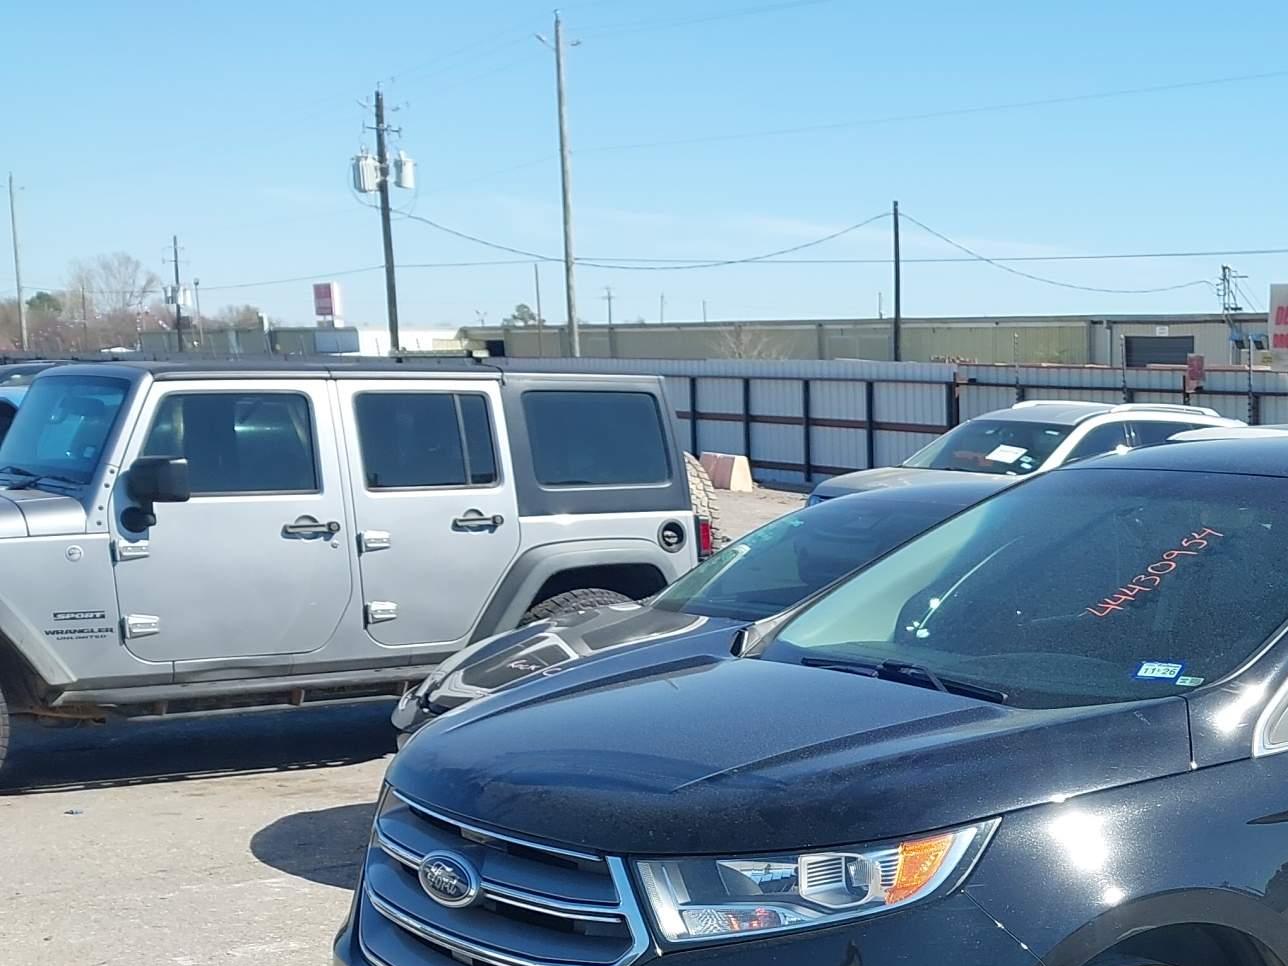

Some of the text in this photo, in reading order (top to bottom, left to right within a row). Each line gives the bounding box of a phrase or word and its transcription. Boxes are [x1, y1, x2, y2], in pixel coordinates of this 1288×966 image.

[1086, 526, 1224, 617] 44430954
[55, 611, 105, 621] SPORT
[44, 626, 114, 636] WRANGLER
[425, 860, 459, 895] Ford
